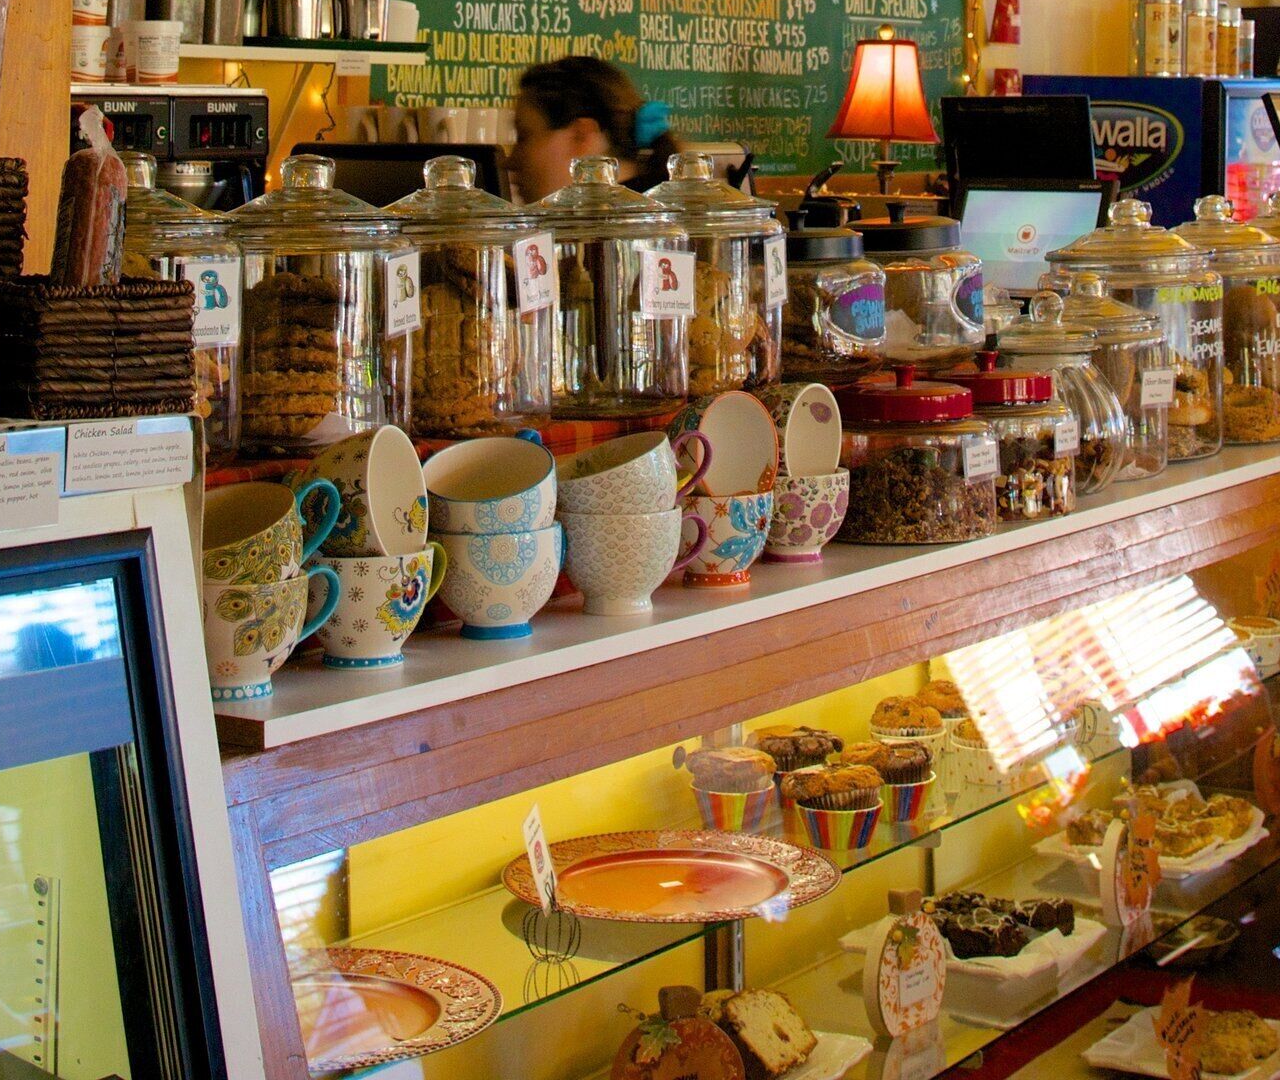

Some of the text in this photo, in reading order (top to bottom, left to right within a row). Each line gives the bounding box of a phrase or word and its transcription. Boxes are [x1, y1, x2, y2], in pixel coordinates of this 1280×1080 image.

[453, 1, 572, 35] 3 PANCAKES $5.25
[639, 13, 677, 43] BAGEL
[639, 40, 804, 76] PANCAKE BREAKFAST SANDWICH
[104, 102, 134, 114] BUNN
[207, 102, 236, 114] BUNN
[1091, 116, 1168, 150] walla
[74, 424, 134, 440] Chicken Salad
